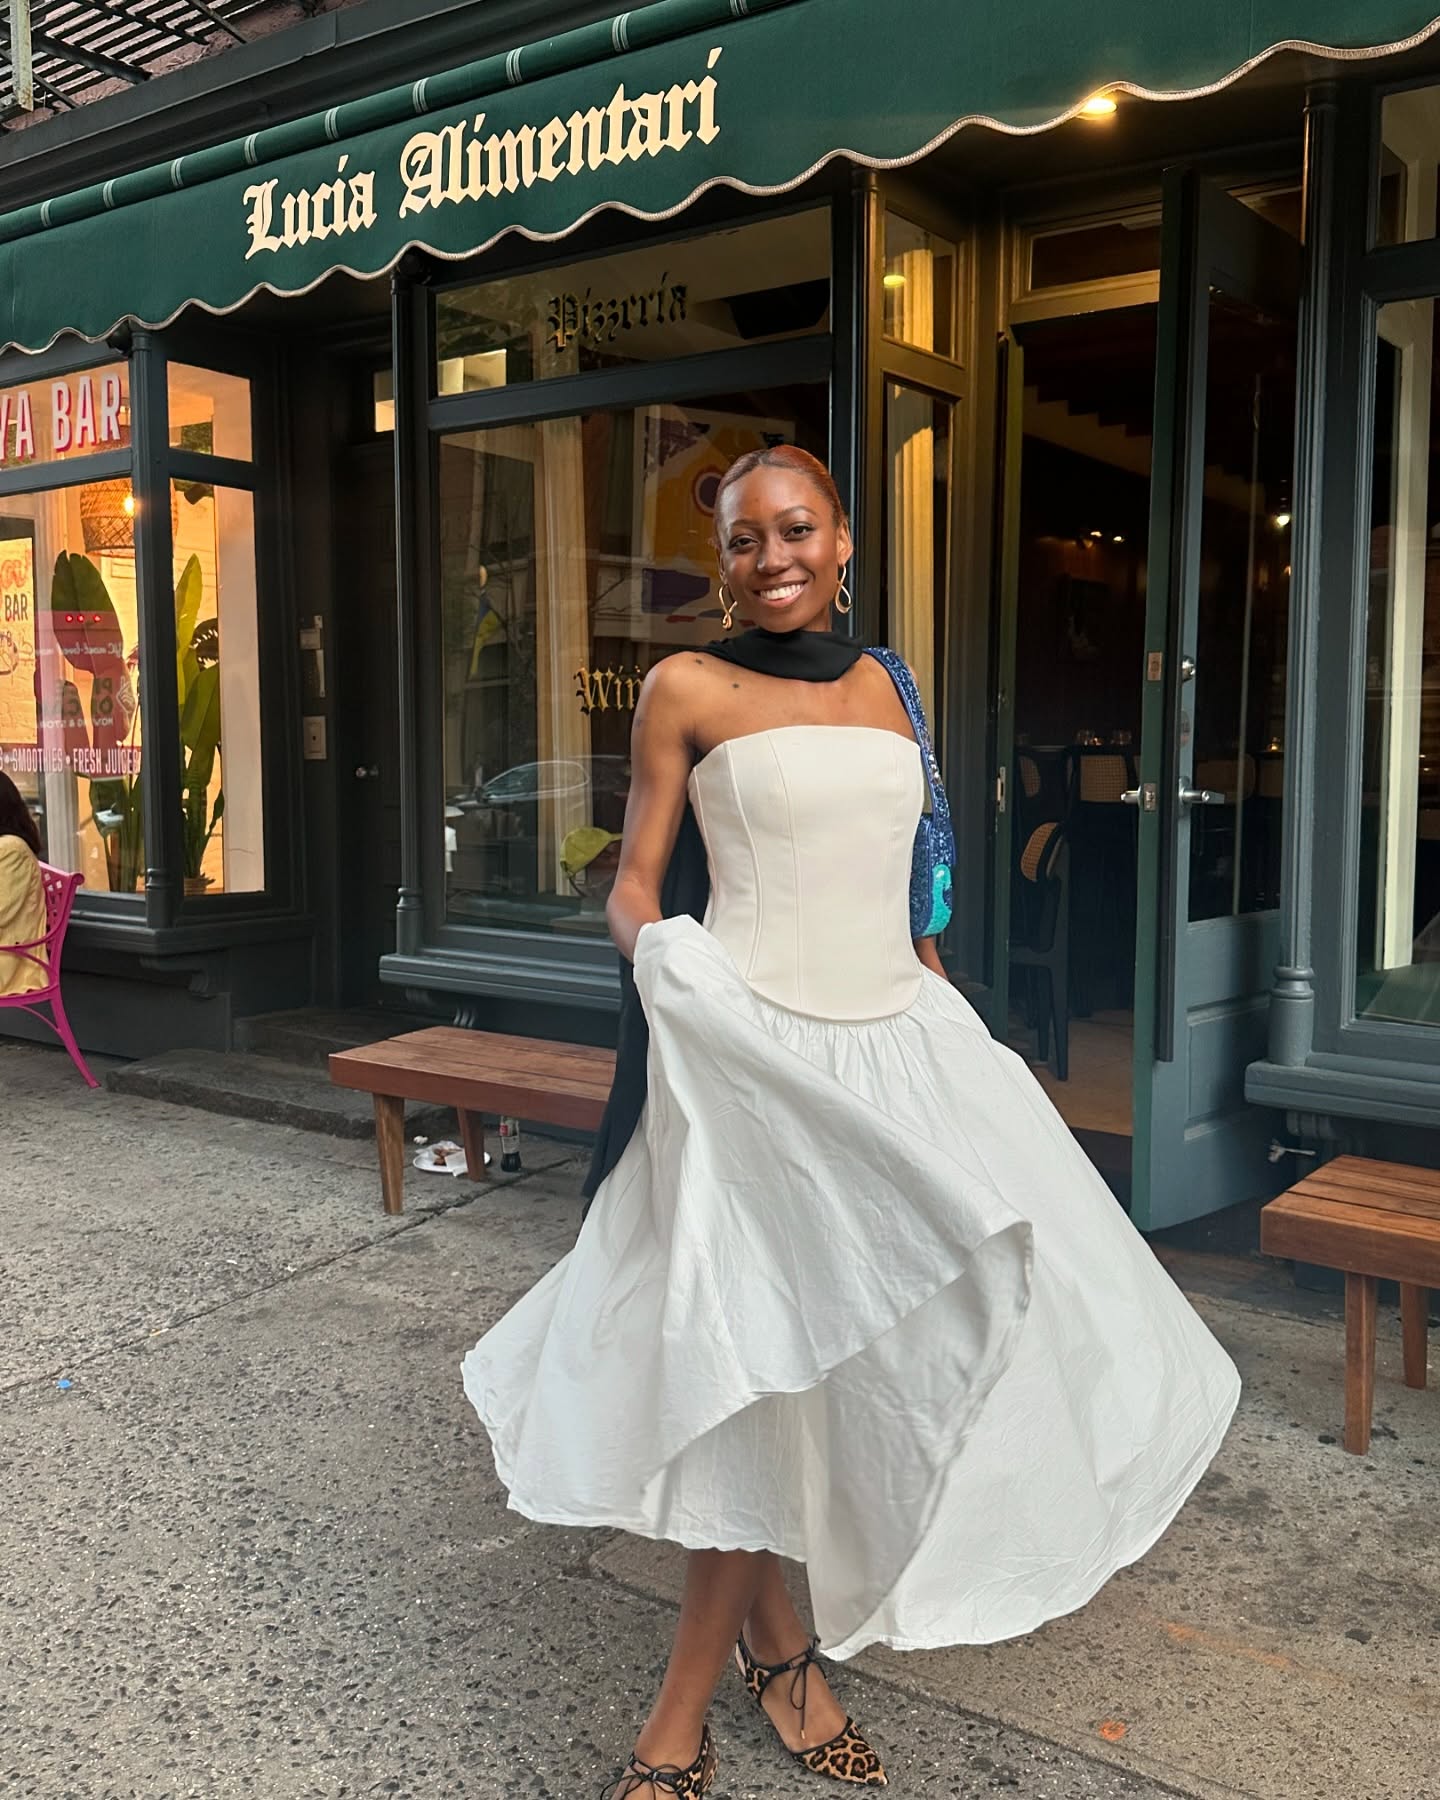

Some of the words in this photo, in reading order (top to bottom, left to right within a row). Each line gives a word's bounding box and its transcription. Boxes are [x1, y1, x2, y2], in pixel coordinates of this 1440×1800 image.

[51, 373, 123, 453] BAR
[4, 593, 29, 622] BAR
[12, 747, 63, 773] SMOOTHIES
[73, 747, 102, 774] FRESH
